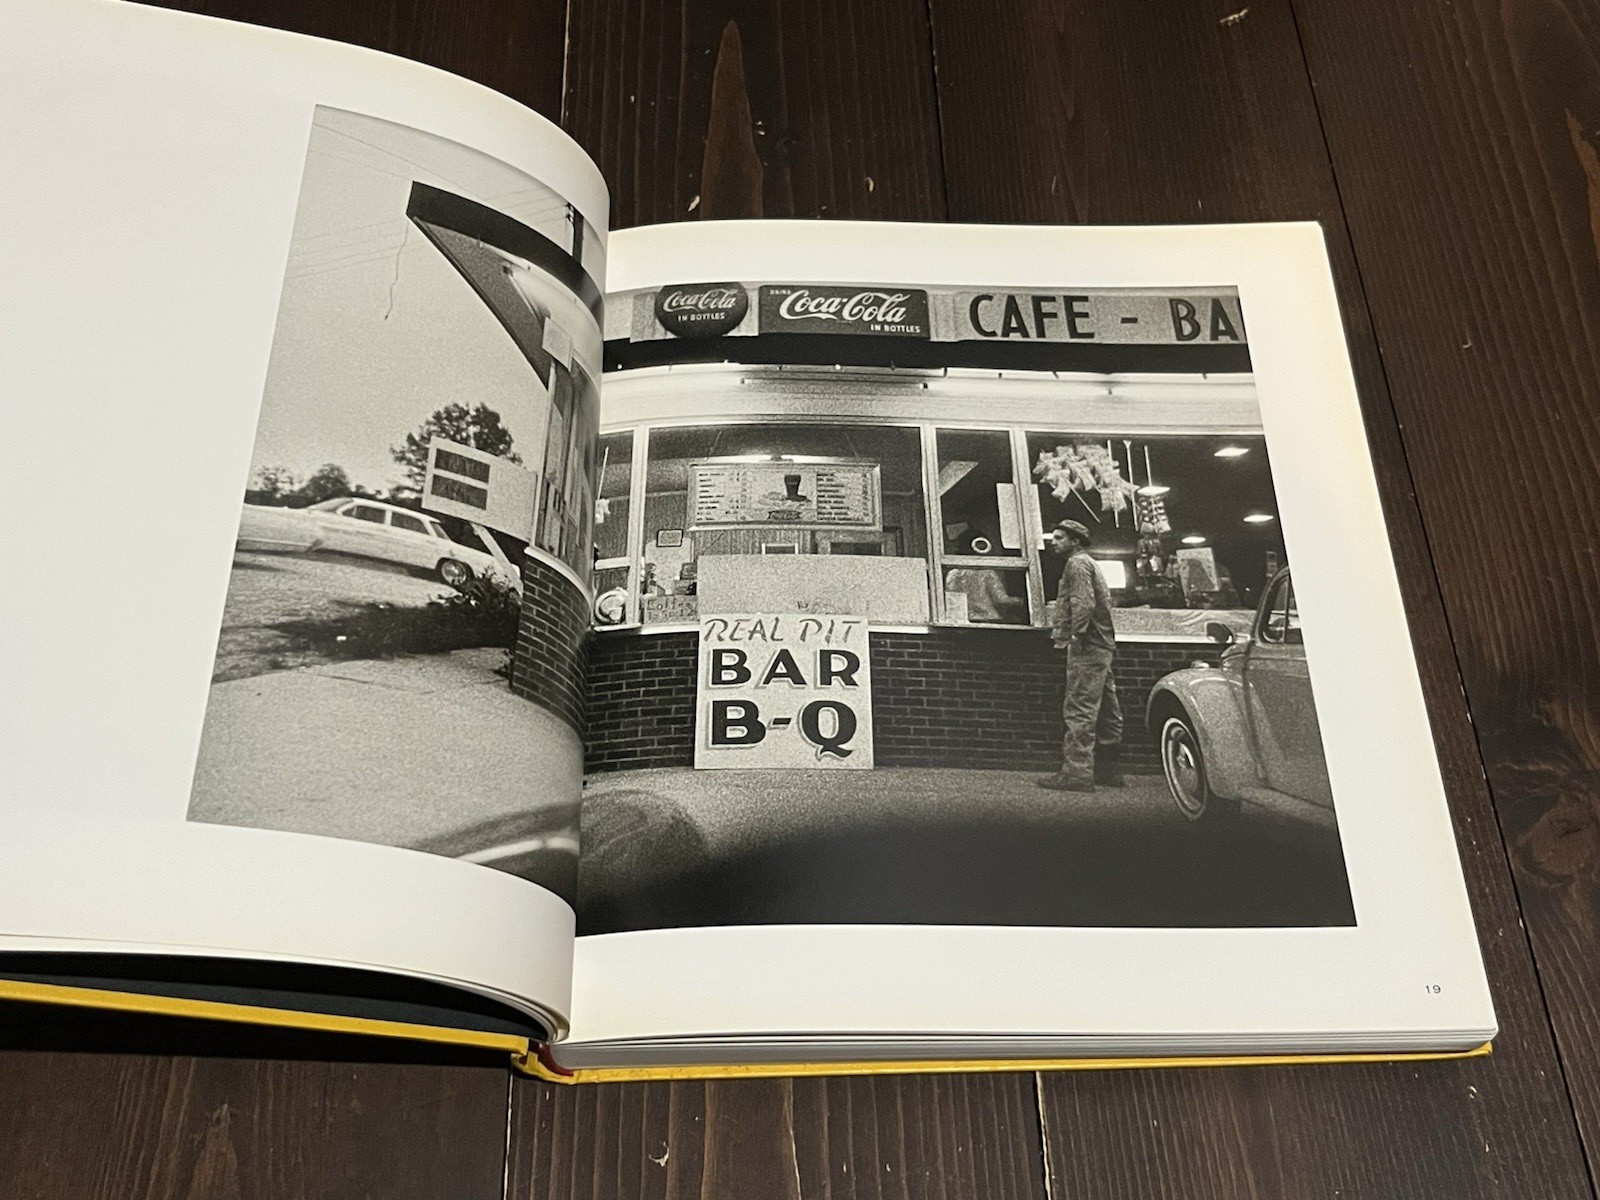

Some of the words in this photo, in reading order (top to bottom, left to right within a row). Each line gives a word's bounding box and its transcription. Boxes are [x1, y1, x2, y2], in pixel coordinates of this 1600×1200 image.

[662, 288, 739, 312] Coca-Cola
[779, 289, 911, 323] Coca-Cola
[690, 312, 726, 321] BOTTLES
[870, 323, 881, 331] IN
[884, 324, 921, 333] BOTTLES
[969, 294, 1095, 339] CAFE
[1168, 298, 1239, 341] BA
[703, 616, 784, 643] REAL
[799, 618, 861, 644] PIT
[705, 648, 860, 690] BAR
[705, 699, 857, 761] B-Q
[1425, 984, 1441, 994] 19
